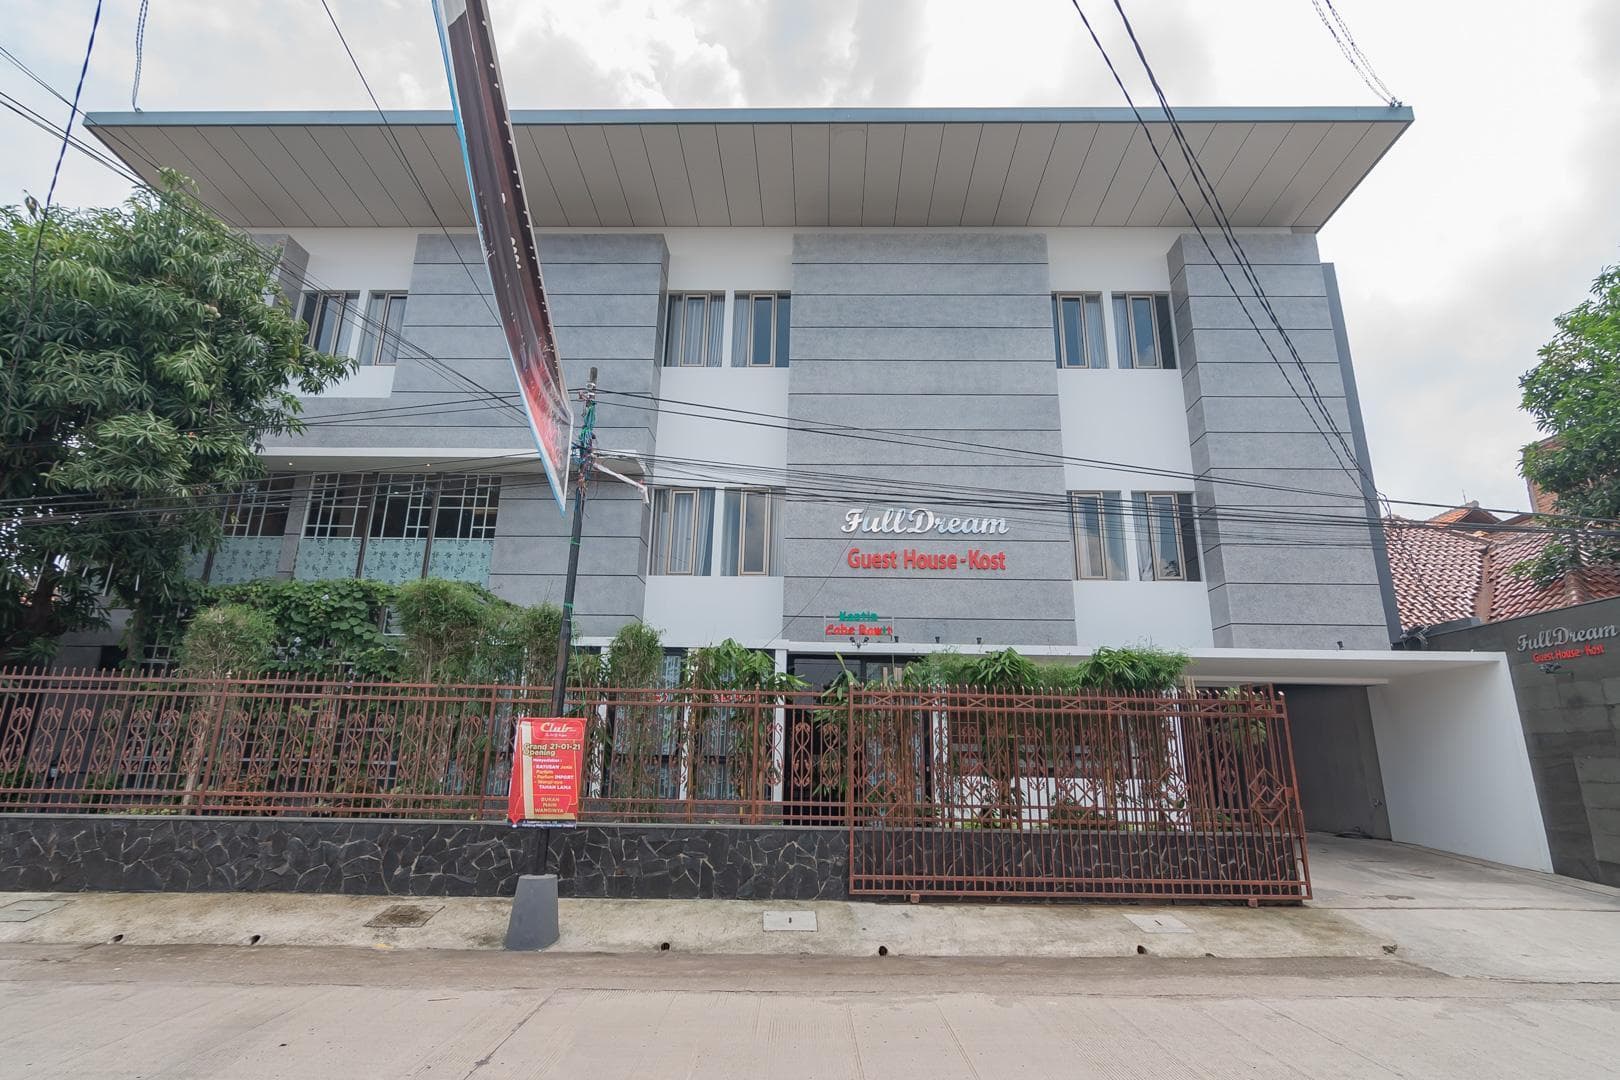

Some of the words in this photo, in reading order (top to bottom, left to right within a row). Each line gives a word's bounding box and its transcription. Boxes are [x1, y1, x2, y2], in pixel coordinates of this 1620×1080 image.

[847, 548, 897, 570] Guest
[1532, 651, 1554, 663] Guest
[540, 722, 576, 733] Club
[523, 743, 548, 751] Grand
[549, 743, 581, 751] 21-01-21
[523, 749, 556, 757] Opening
